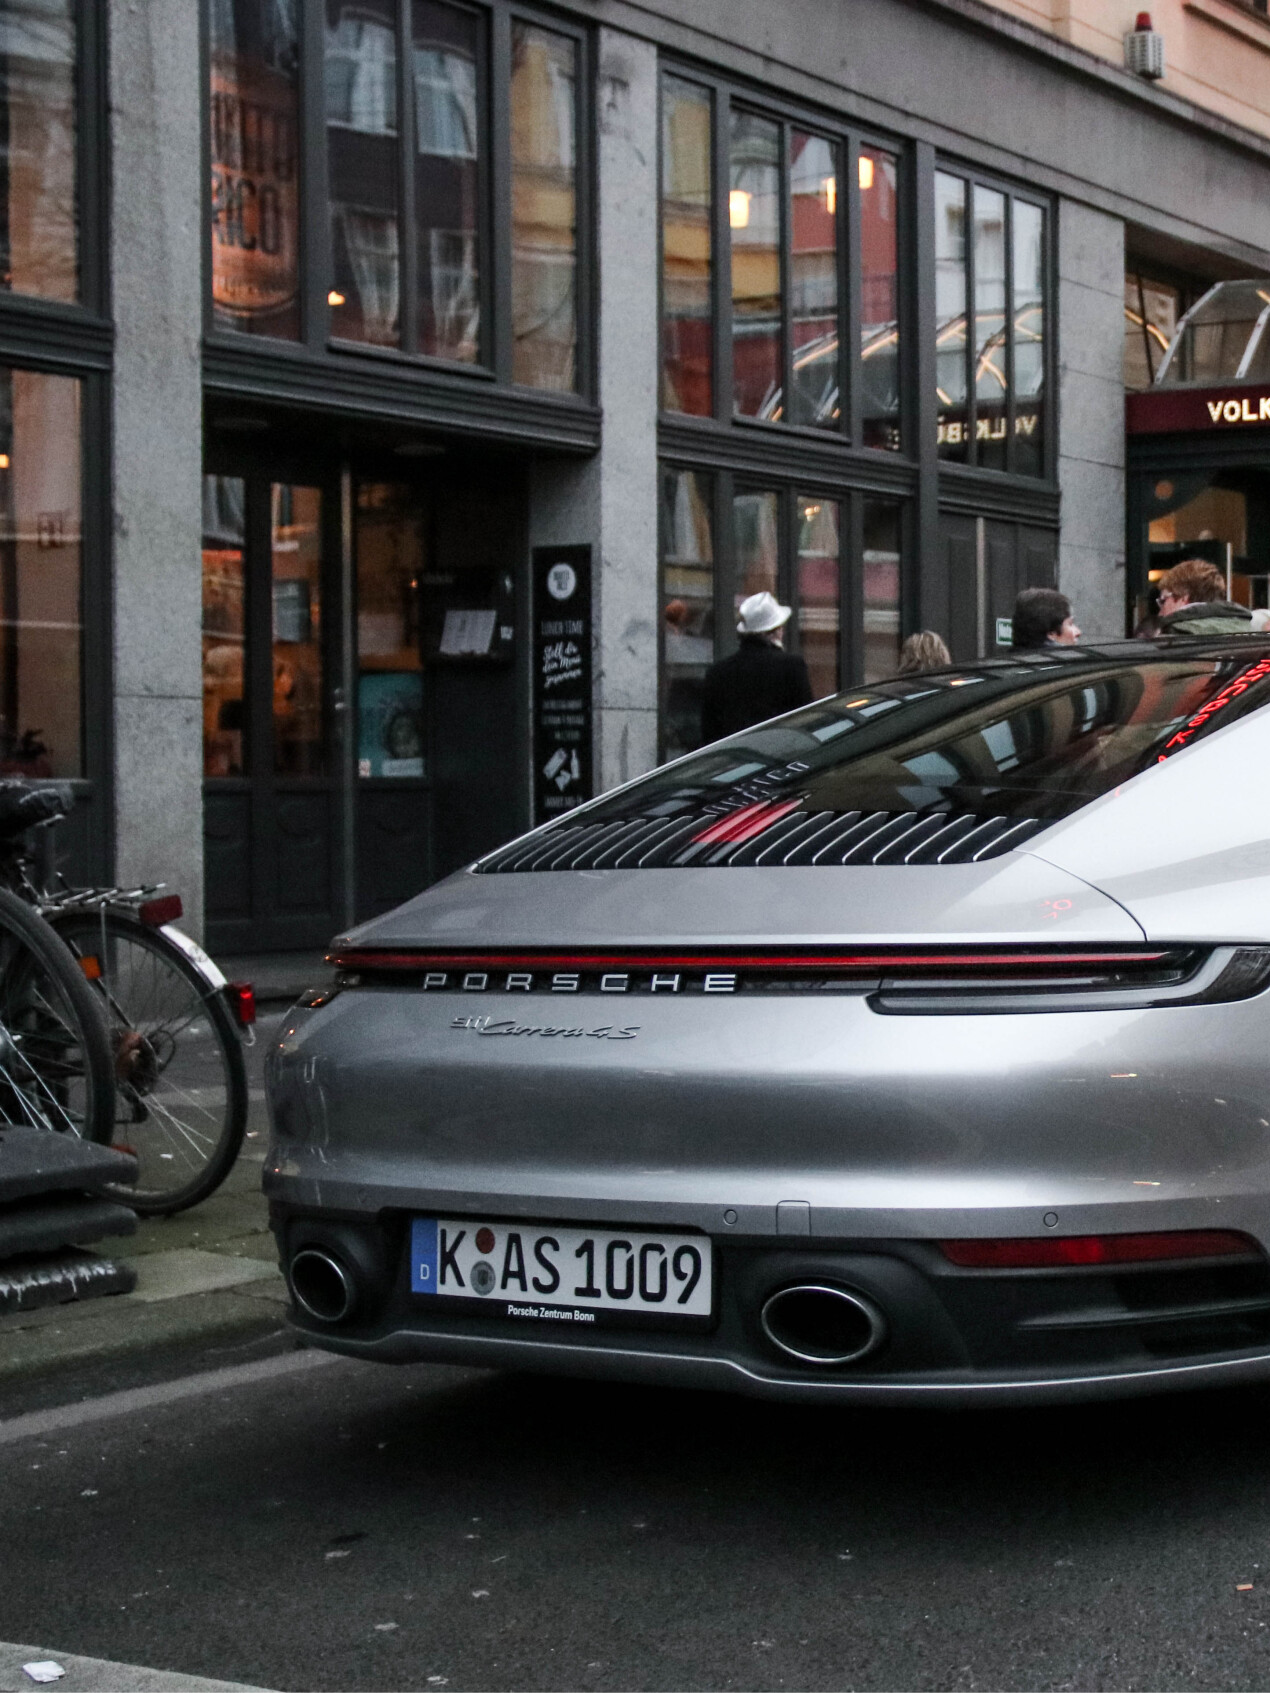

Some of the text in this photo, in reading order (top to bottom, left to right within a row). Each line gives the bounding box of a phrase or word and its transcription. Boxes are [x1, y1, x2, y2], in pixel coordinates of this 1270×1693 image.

[424, 973, 736, 992] PORSCHE
[479, 1016, 583, 1036] Carrera
[420, 1228, 702, 1304] D K AS 1009
[508, 1304, 595, 1322] Porsche Zentrum Bonn
